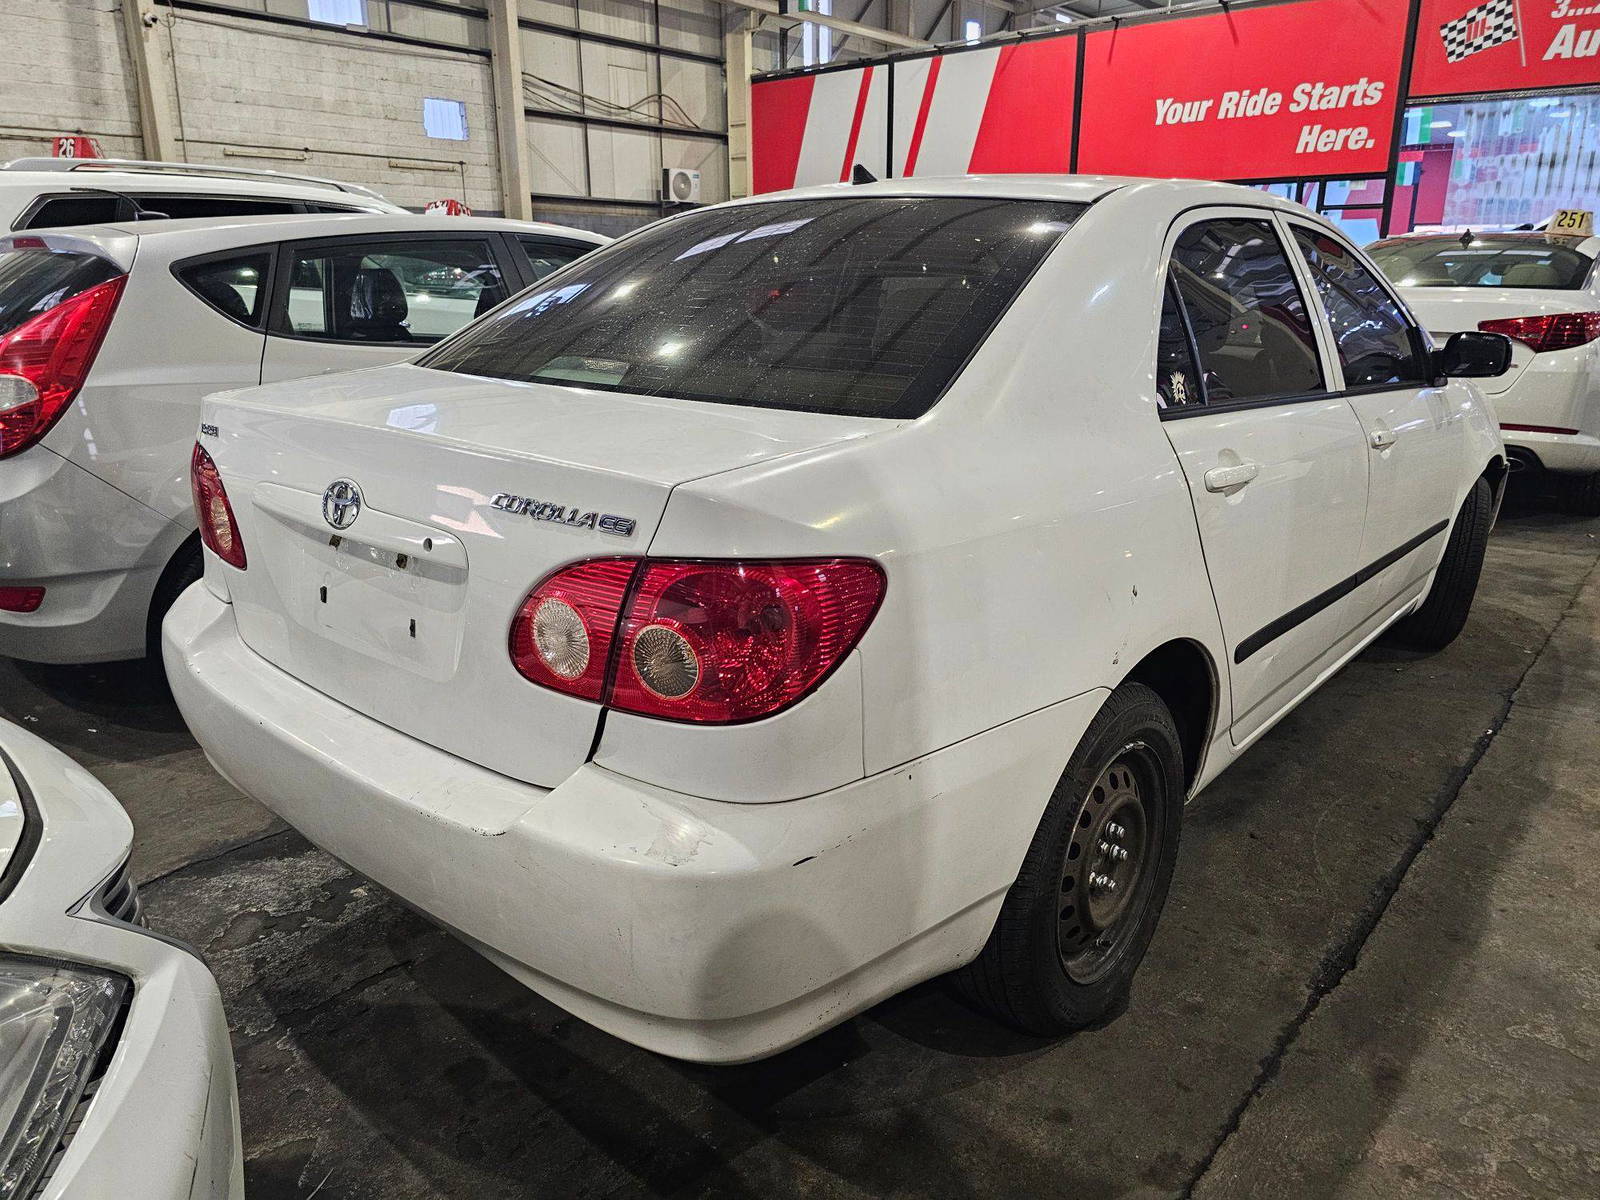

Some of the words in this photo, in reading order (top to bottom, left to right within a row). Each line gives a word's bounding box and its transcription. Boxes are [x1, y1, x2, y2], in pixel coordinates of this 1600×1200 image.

[1154, 97, 1214, 126] Your
[1216, 87, 1283, 120] Ride
[1288, 77, 1385, 113] Starts
[58, 138, 76, 159] 26
[1295, 124, 1376, 154] Here.
[1557, 211, 1586, 229] 251
[489, 492, 599, 530] COROLLA
